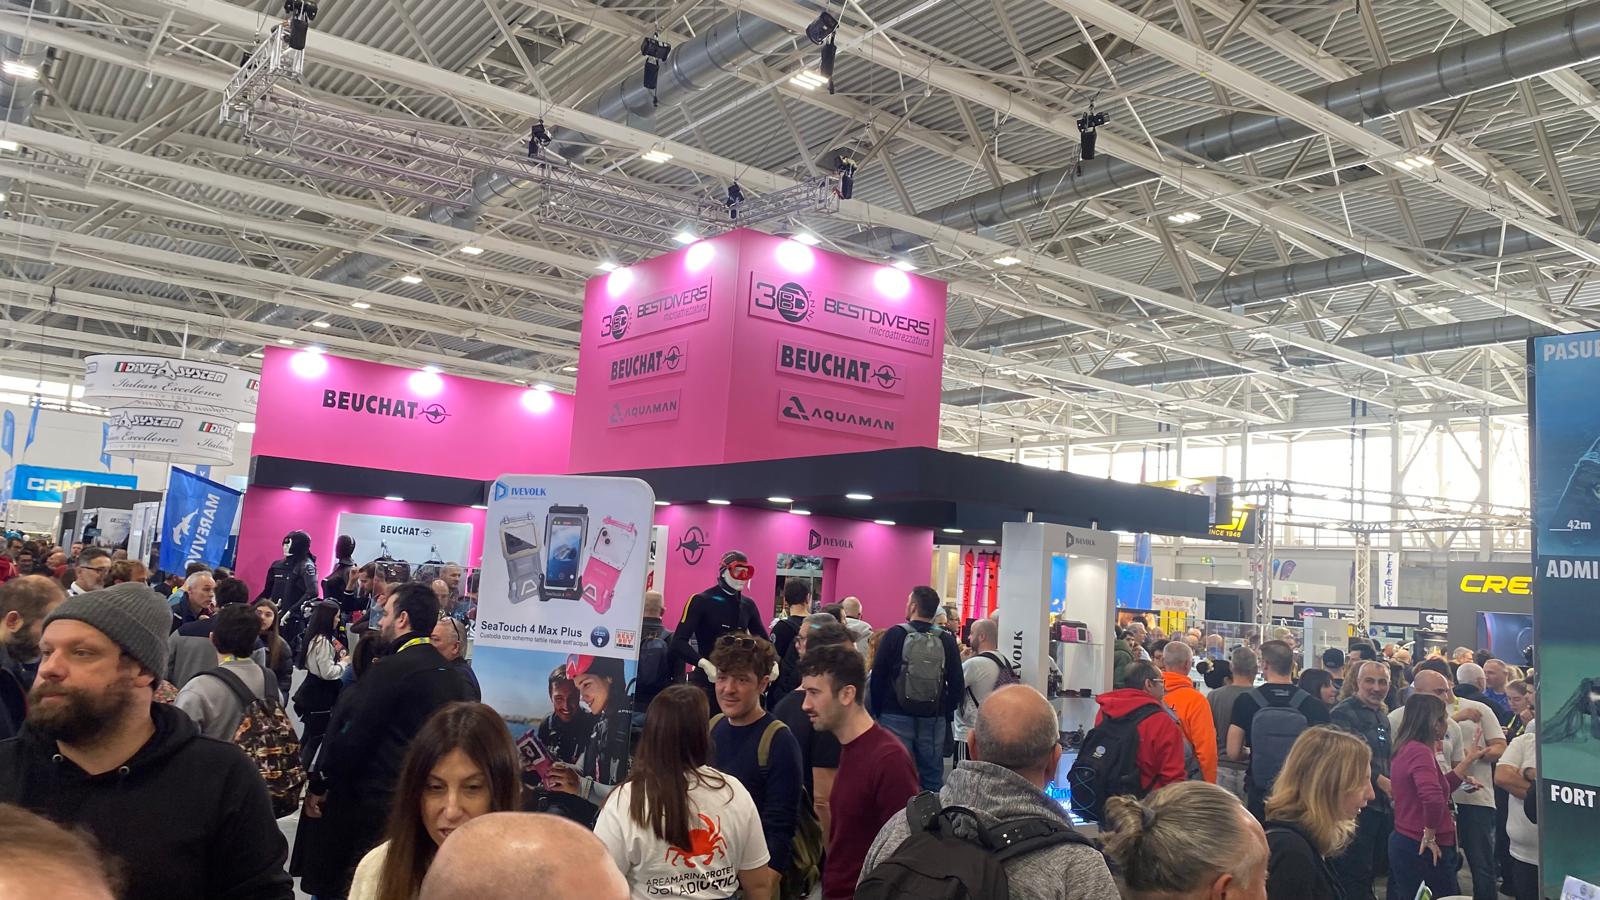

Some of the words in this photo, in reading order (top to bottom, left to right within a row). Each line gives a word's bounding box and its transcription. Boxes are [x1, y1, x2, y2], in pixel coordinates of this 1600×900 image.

[611, 350, 663, 381] BEUCHAT
[781, 344, 870, 383] BEUCHAT
[112, 376, 157, 390] Italian
[162, 381, 222, 397] Excellence
[322, 389, 418, 419] BEUCHAT
[625, 400, 677, 417] AQUAMAN
[812, 408, 894, 431] AQUAMAN
[380, 525, 420, 536] BEUCHAT
[1567, 519, 1591, 530] 42m
[1545, 559, 1599, 579] ADMI
[1460, 574, 1533, 595] CRE
[481, 620, 527, 633] SeaTouch
[530, 624, 536, 633] 4
[538, 625, 558, 635] Max
[561, 627, 583, 637] Plus
[1551, 784, 1596, 808] FORT
